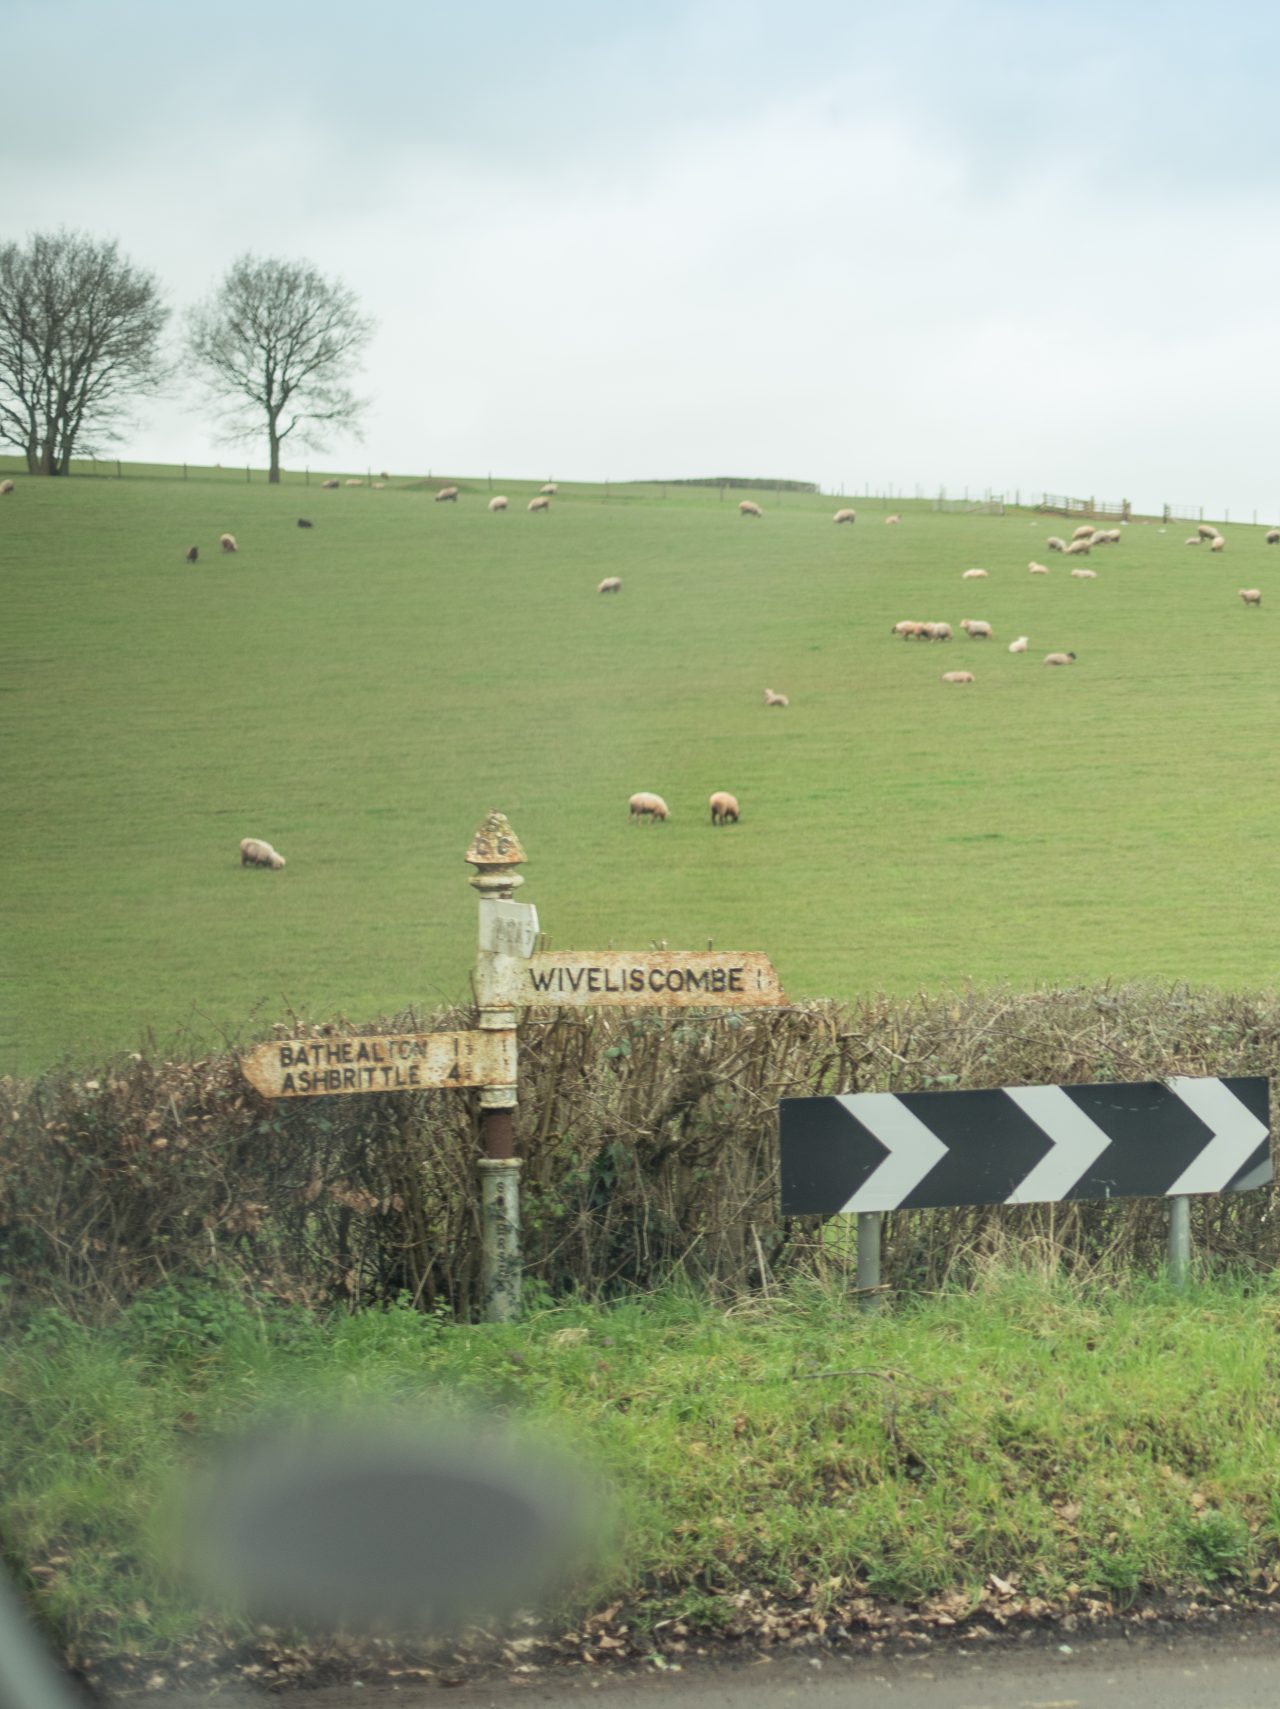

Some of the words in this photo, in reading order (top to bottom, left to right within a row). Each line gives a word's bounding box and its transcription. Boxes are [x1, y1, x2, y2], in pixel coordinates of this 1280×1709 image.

[529, 967, 744, 993] WIVELISCOMBE
[280, 1039, 428, 1067] BATHEALTON
[281, 1065, 420, 1094] ASHBRITTLE
